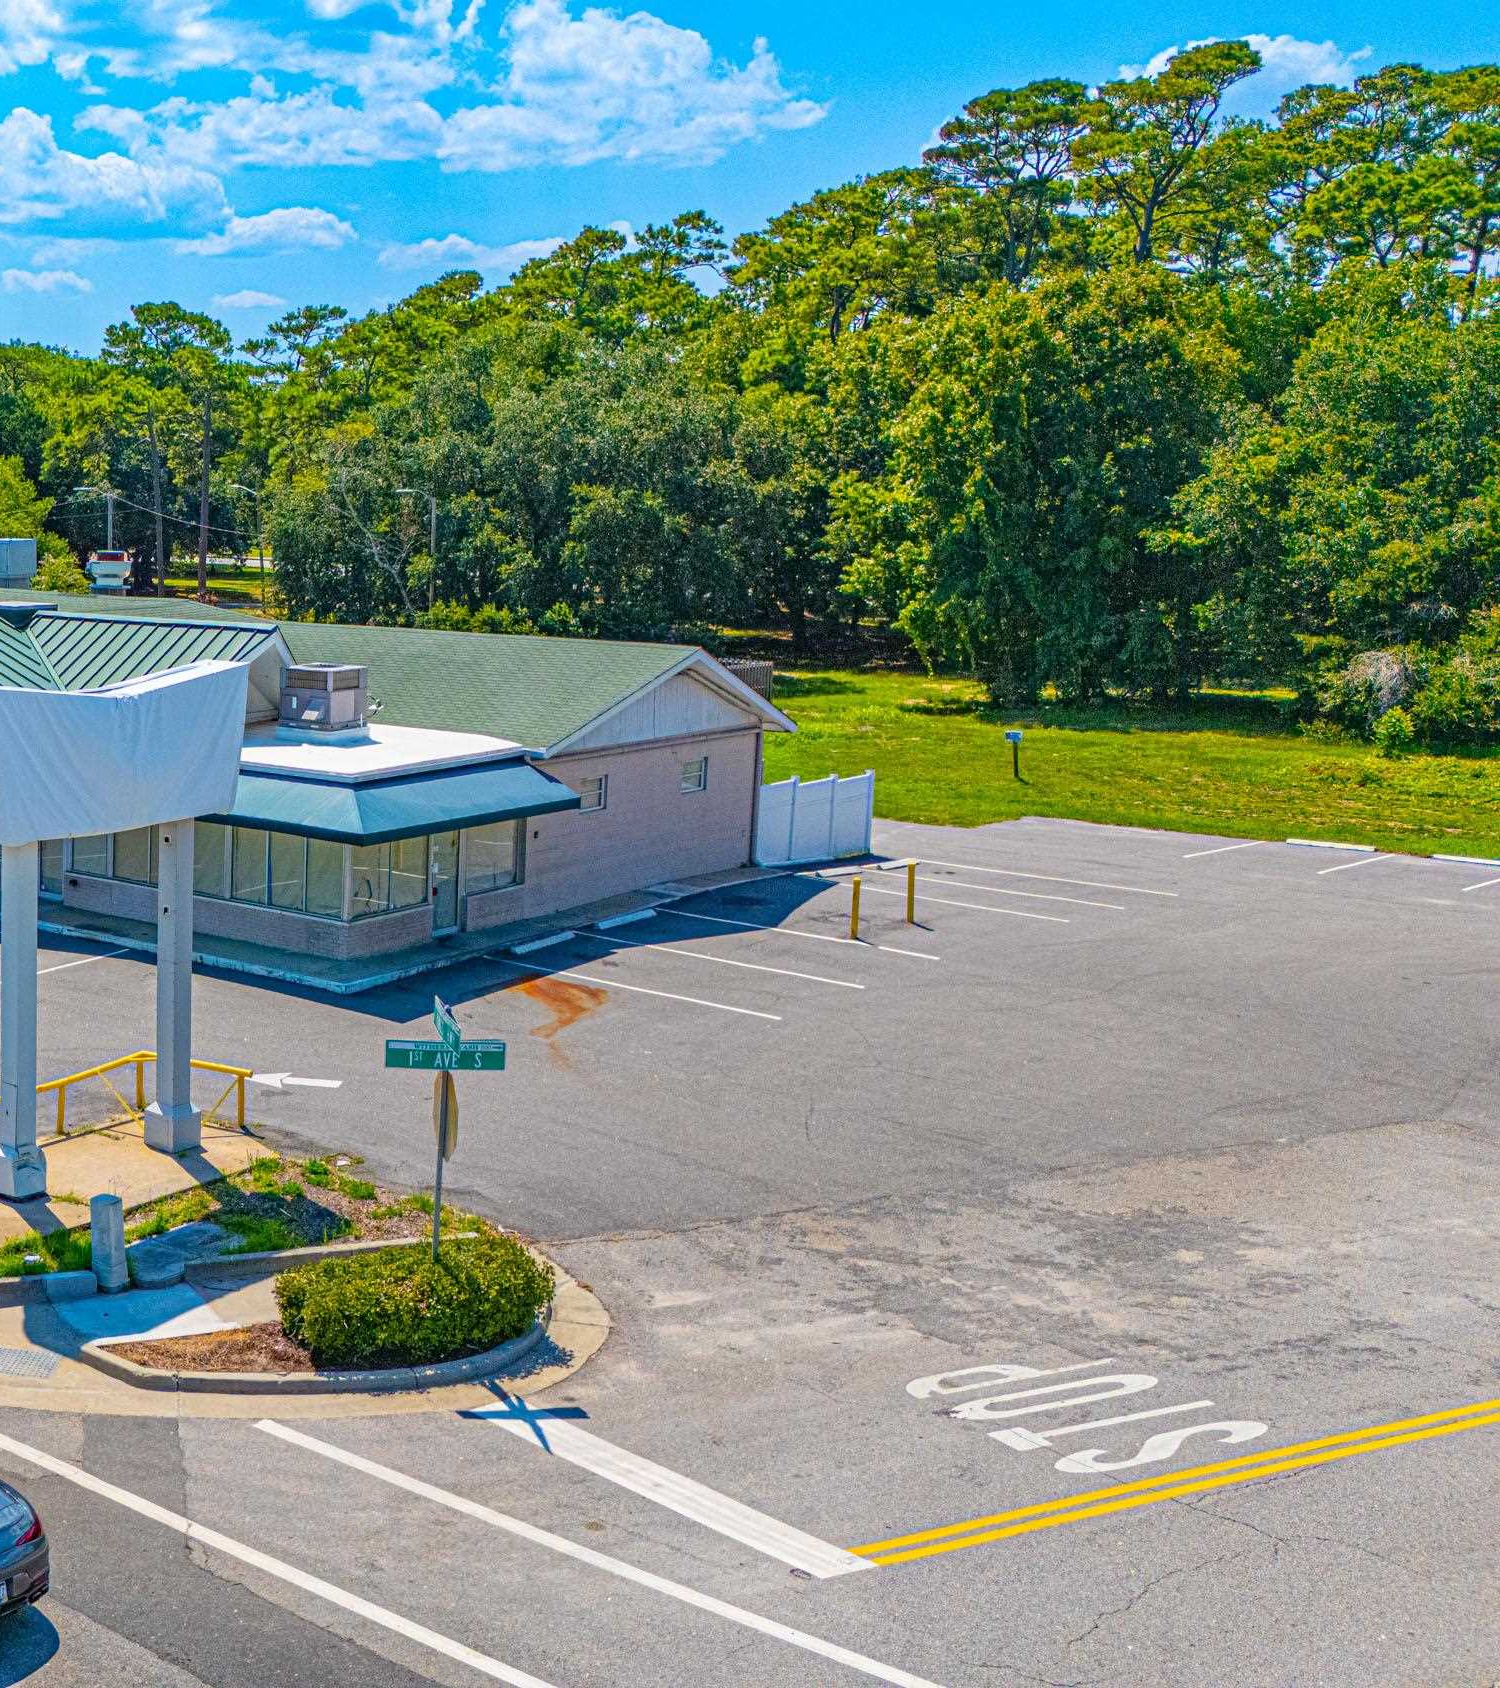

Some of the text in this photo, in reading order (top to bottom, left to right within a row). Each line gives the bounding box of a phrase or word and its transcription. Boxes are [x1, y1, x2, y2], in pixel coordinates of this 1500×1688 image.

[434, 1051, 459, 1068] AVE
[474, 1052, 482, 1068] S
[905, 1357, 1269, 1473] STOP
